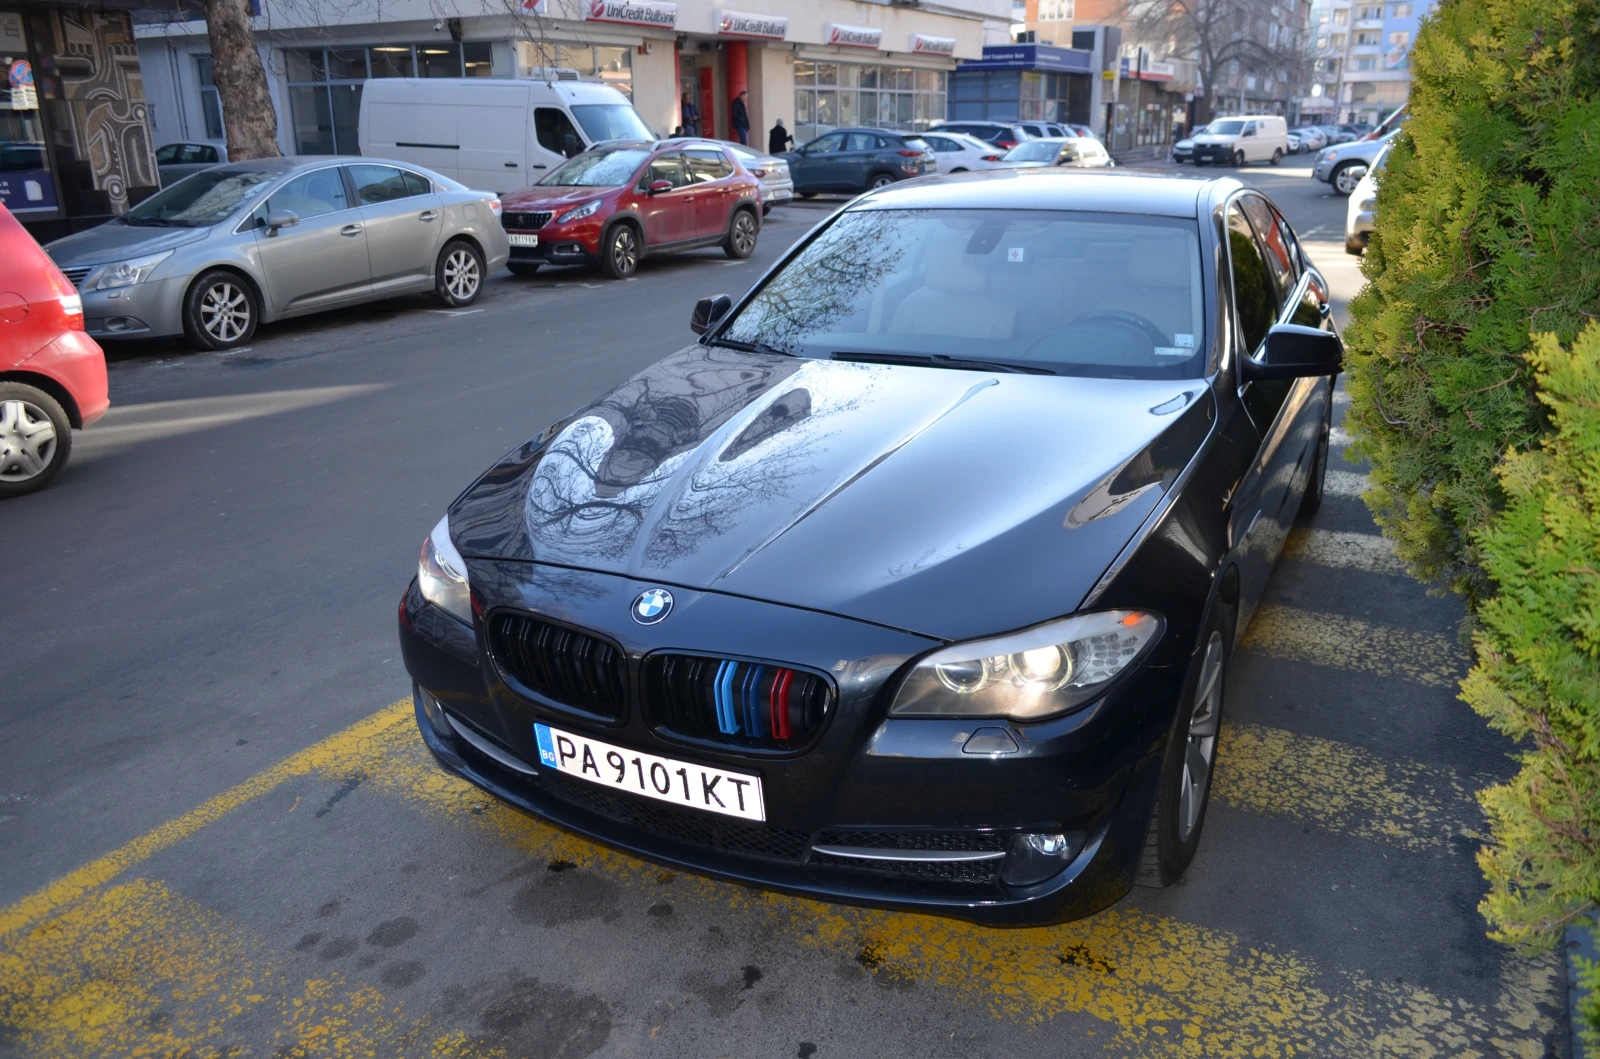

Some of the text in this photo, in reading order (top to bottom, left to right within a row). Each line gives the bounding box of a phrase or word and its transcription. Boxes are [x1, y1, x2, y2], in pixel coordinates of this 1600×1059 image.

[606, 4, 675, 24] UniCredit Bulbank
[734, 18, 785, 35] UniCredit Bulbank
[642, 590, 672, 603] BMW
[542, 749, 555, 762] BG
